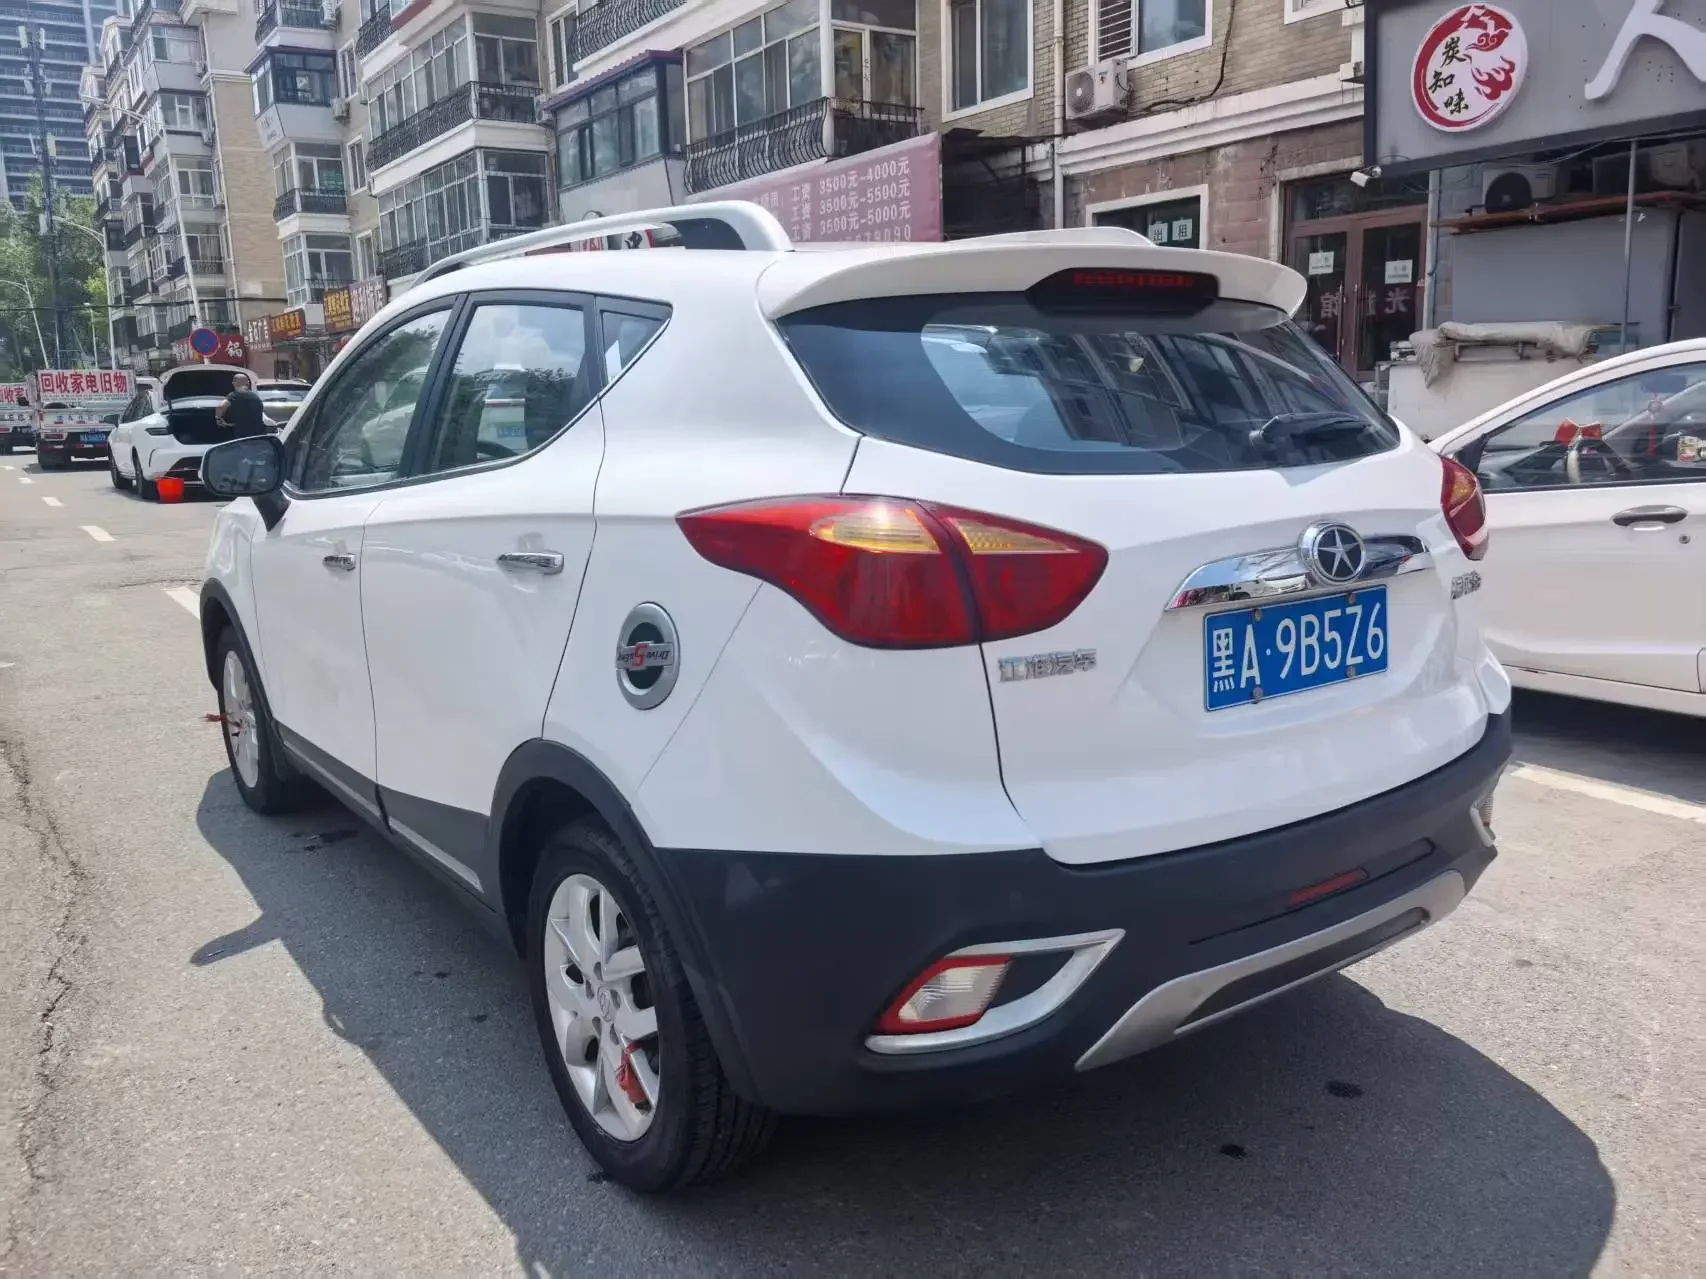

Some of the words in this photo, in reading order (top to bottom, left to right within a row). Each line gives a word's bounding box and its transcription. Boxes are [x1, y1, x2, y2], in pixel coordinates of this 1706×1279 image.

[1428, 37, 1470, 116] 炭知味
[819, 157, 910, 194] 3500元-4000元
[819, 201, 912, 236] 3500元-5000元
[41, 372, 128, 394] 回收家电旧物
